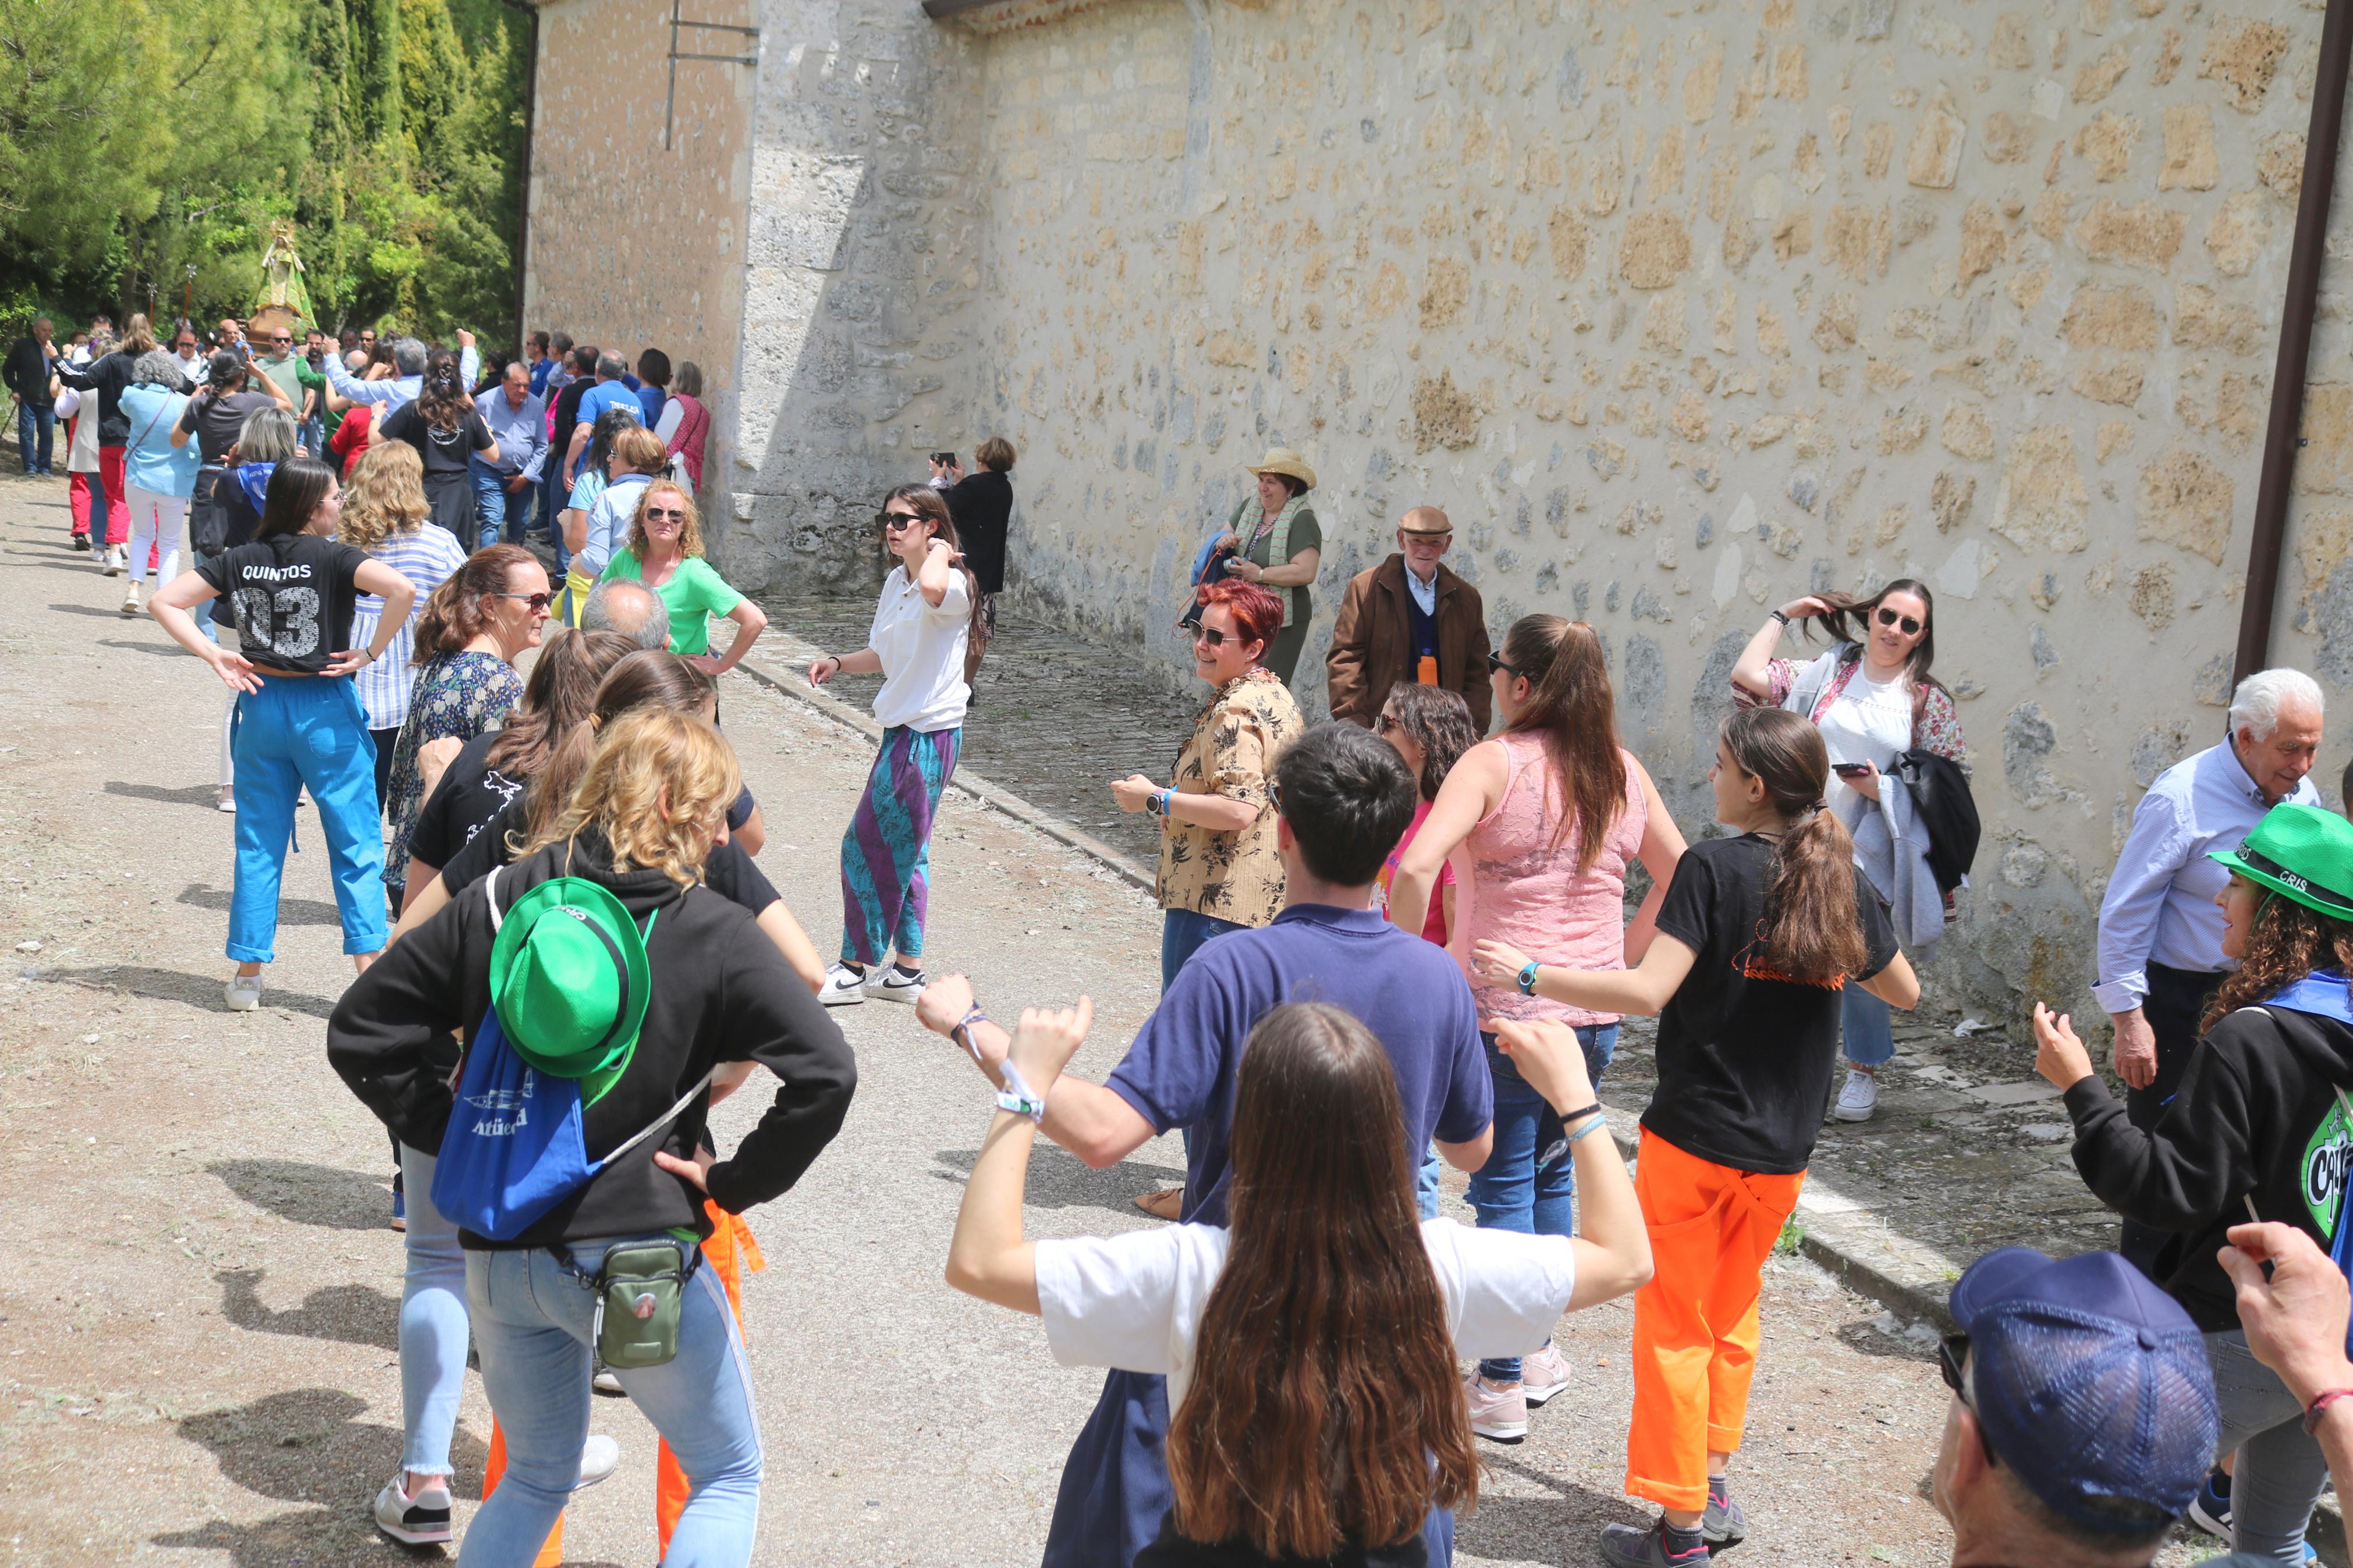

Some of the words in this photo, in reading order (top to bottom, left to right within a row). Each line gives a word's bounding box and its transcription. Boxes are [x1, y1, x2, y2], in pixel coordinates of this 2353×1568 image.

[242, 564, 312, 581] QUINTOS
[232, 586, 320, 658] 03
[2279, 870, 2308, 893] CRIS
